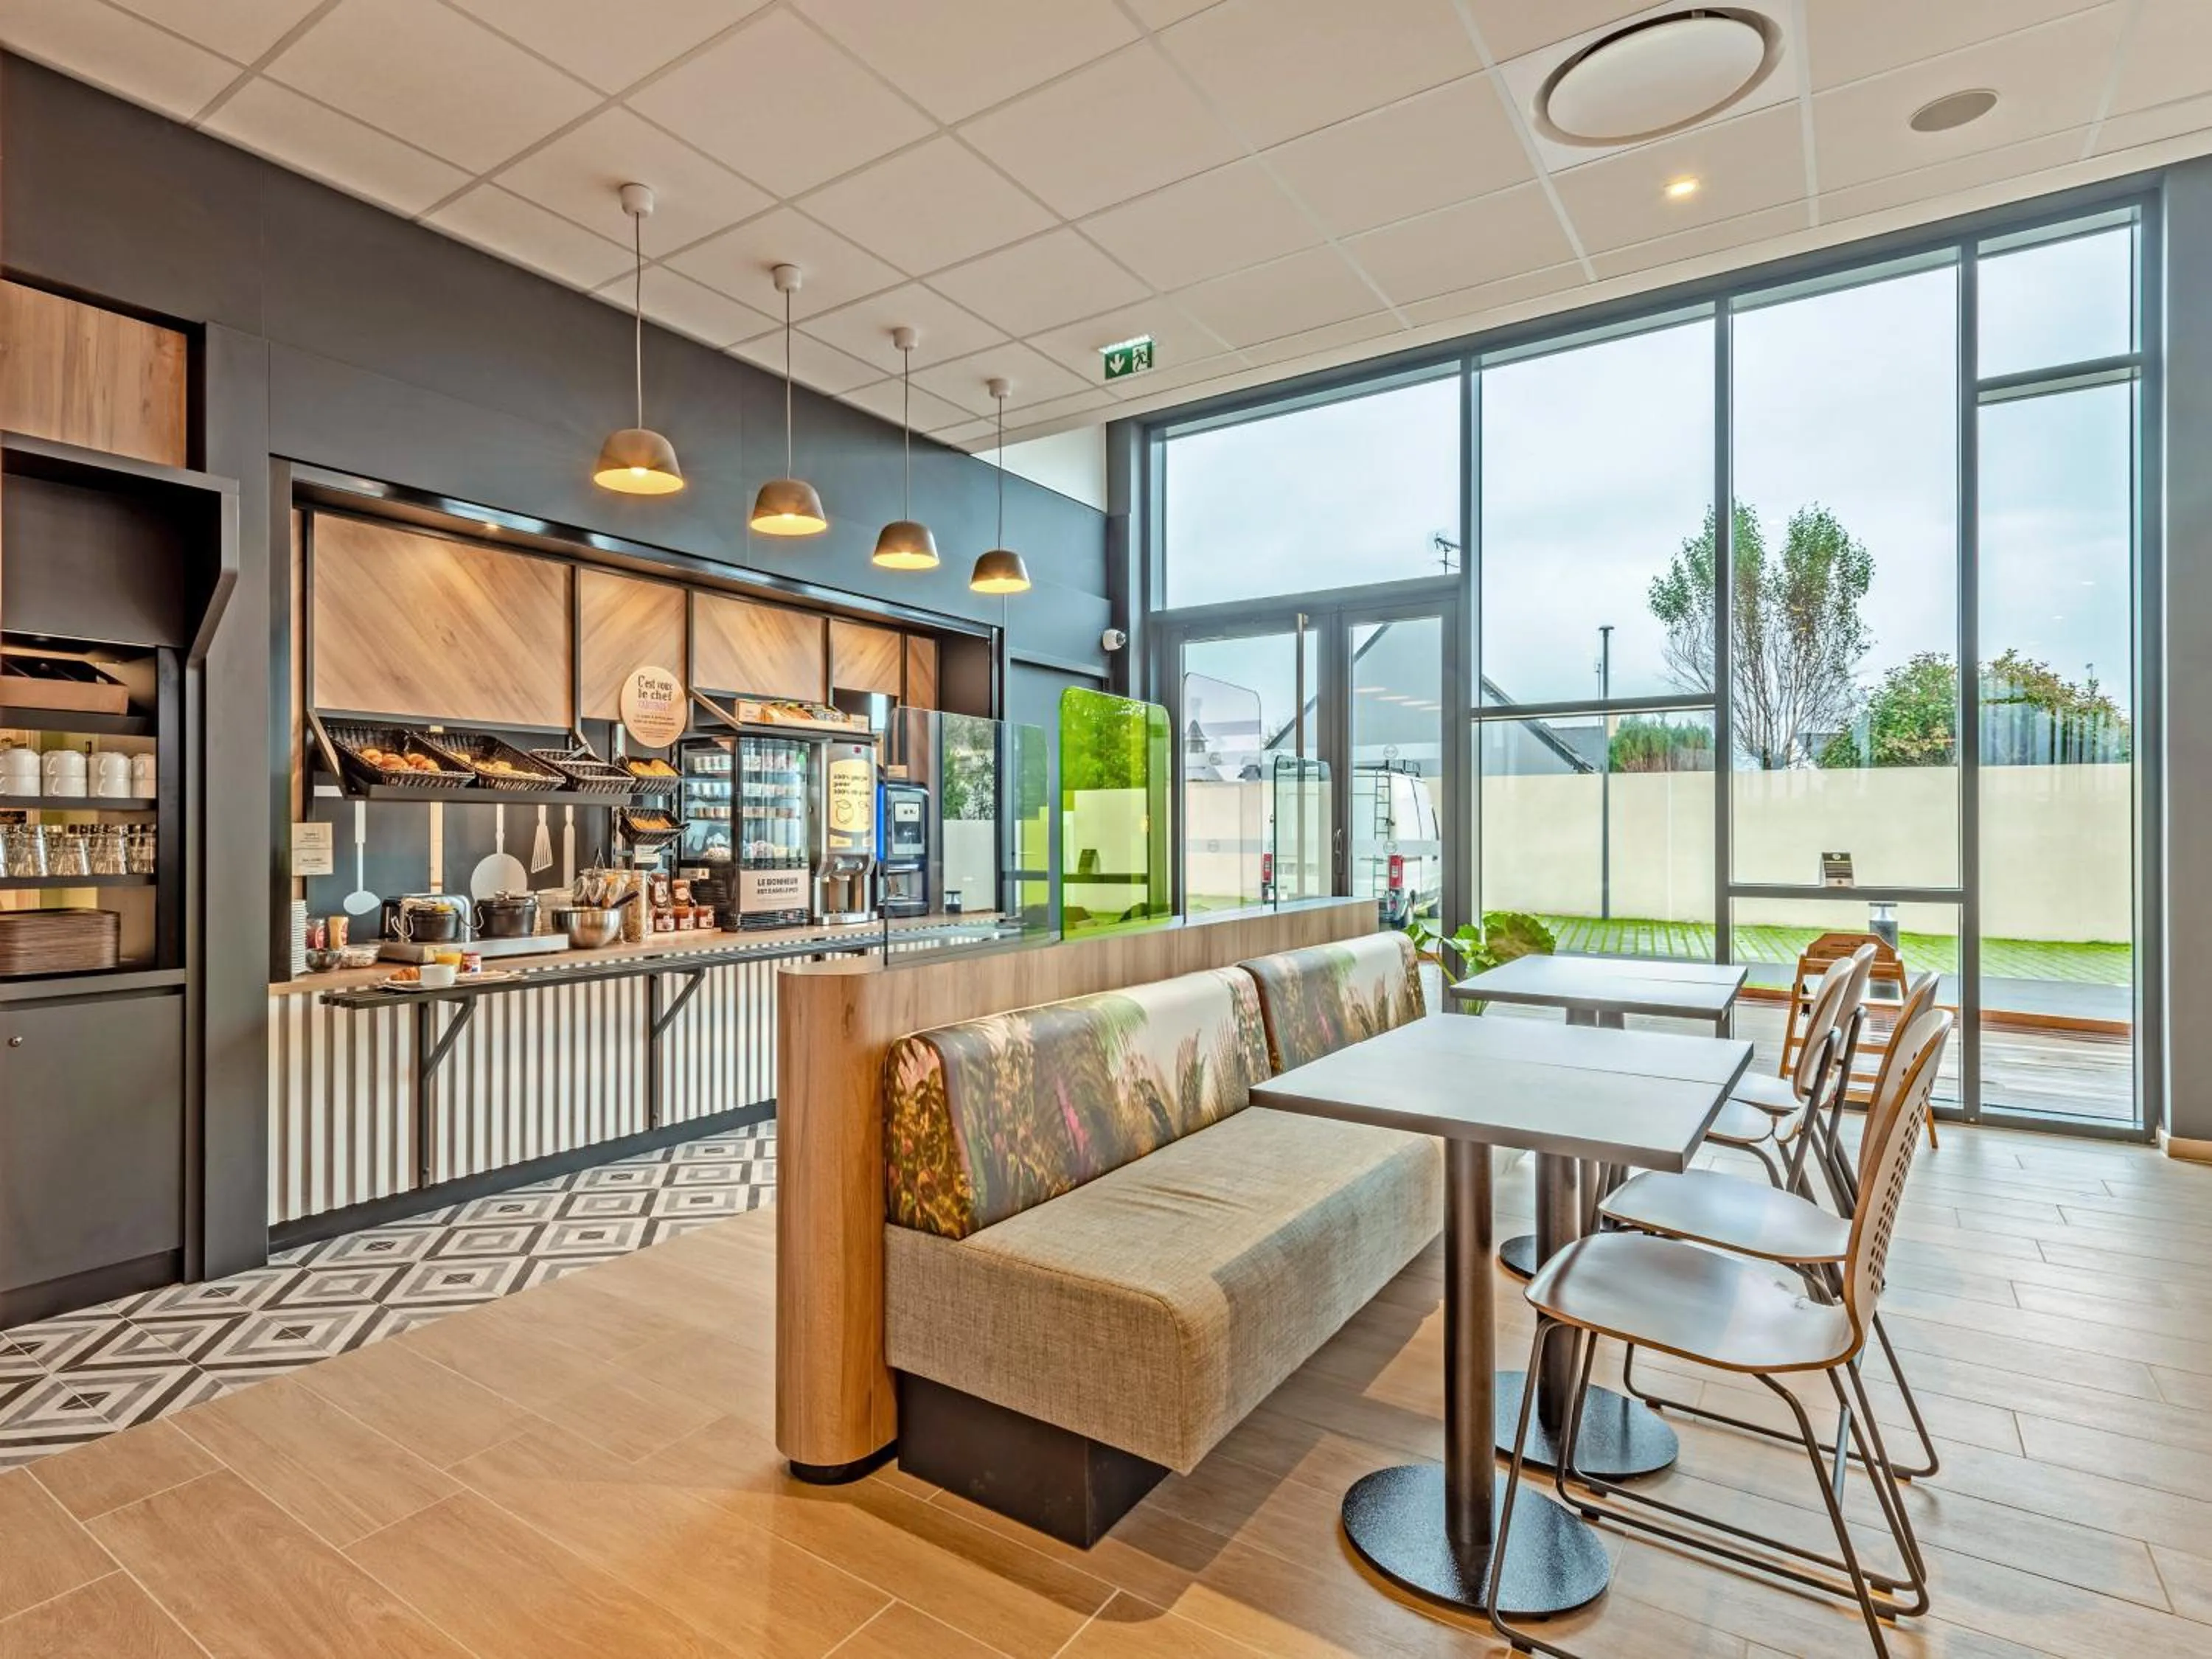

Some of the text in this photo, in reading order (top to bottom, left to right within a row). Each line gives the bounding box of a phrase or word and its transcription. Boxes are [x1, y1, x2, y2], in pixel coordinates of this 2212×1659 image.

[638, 688, 672, 701] le chef
[757, 878, 765, 886] LE
